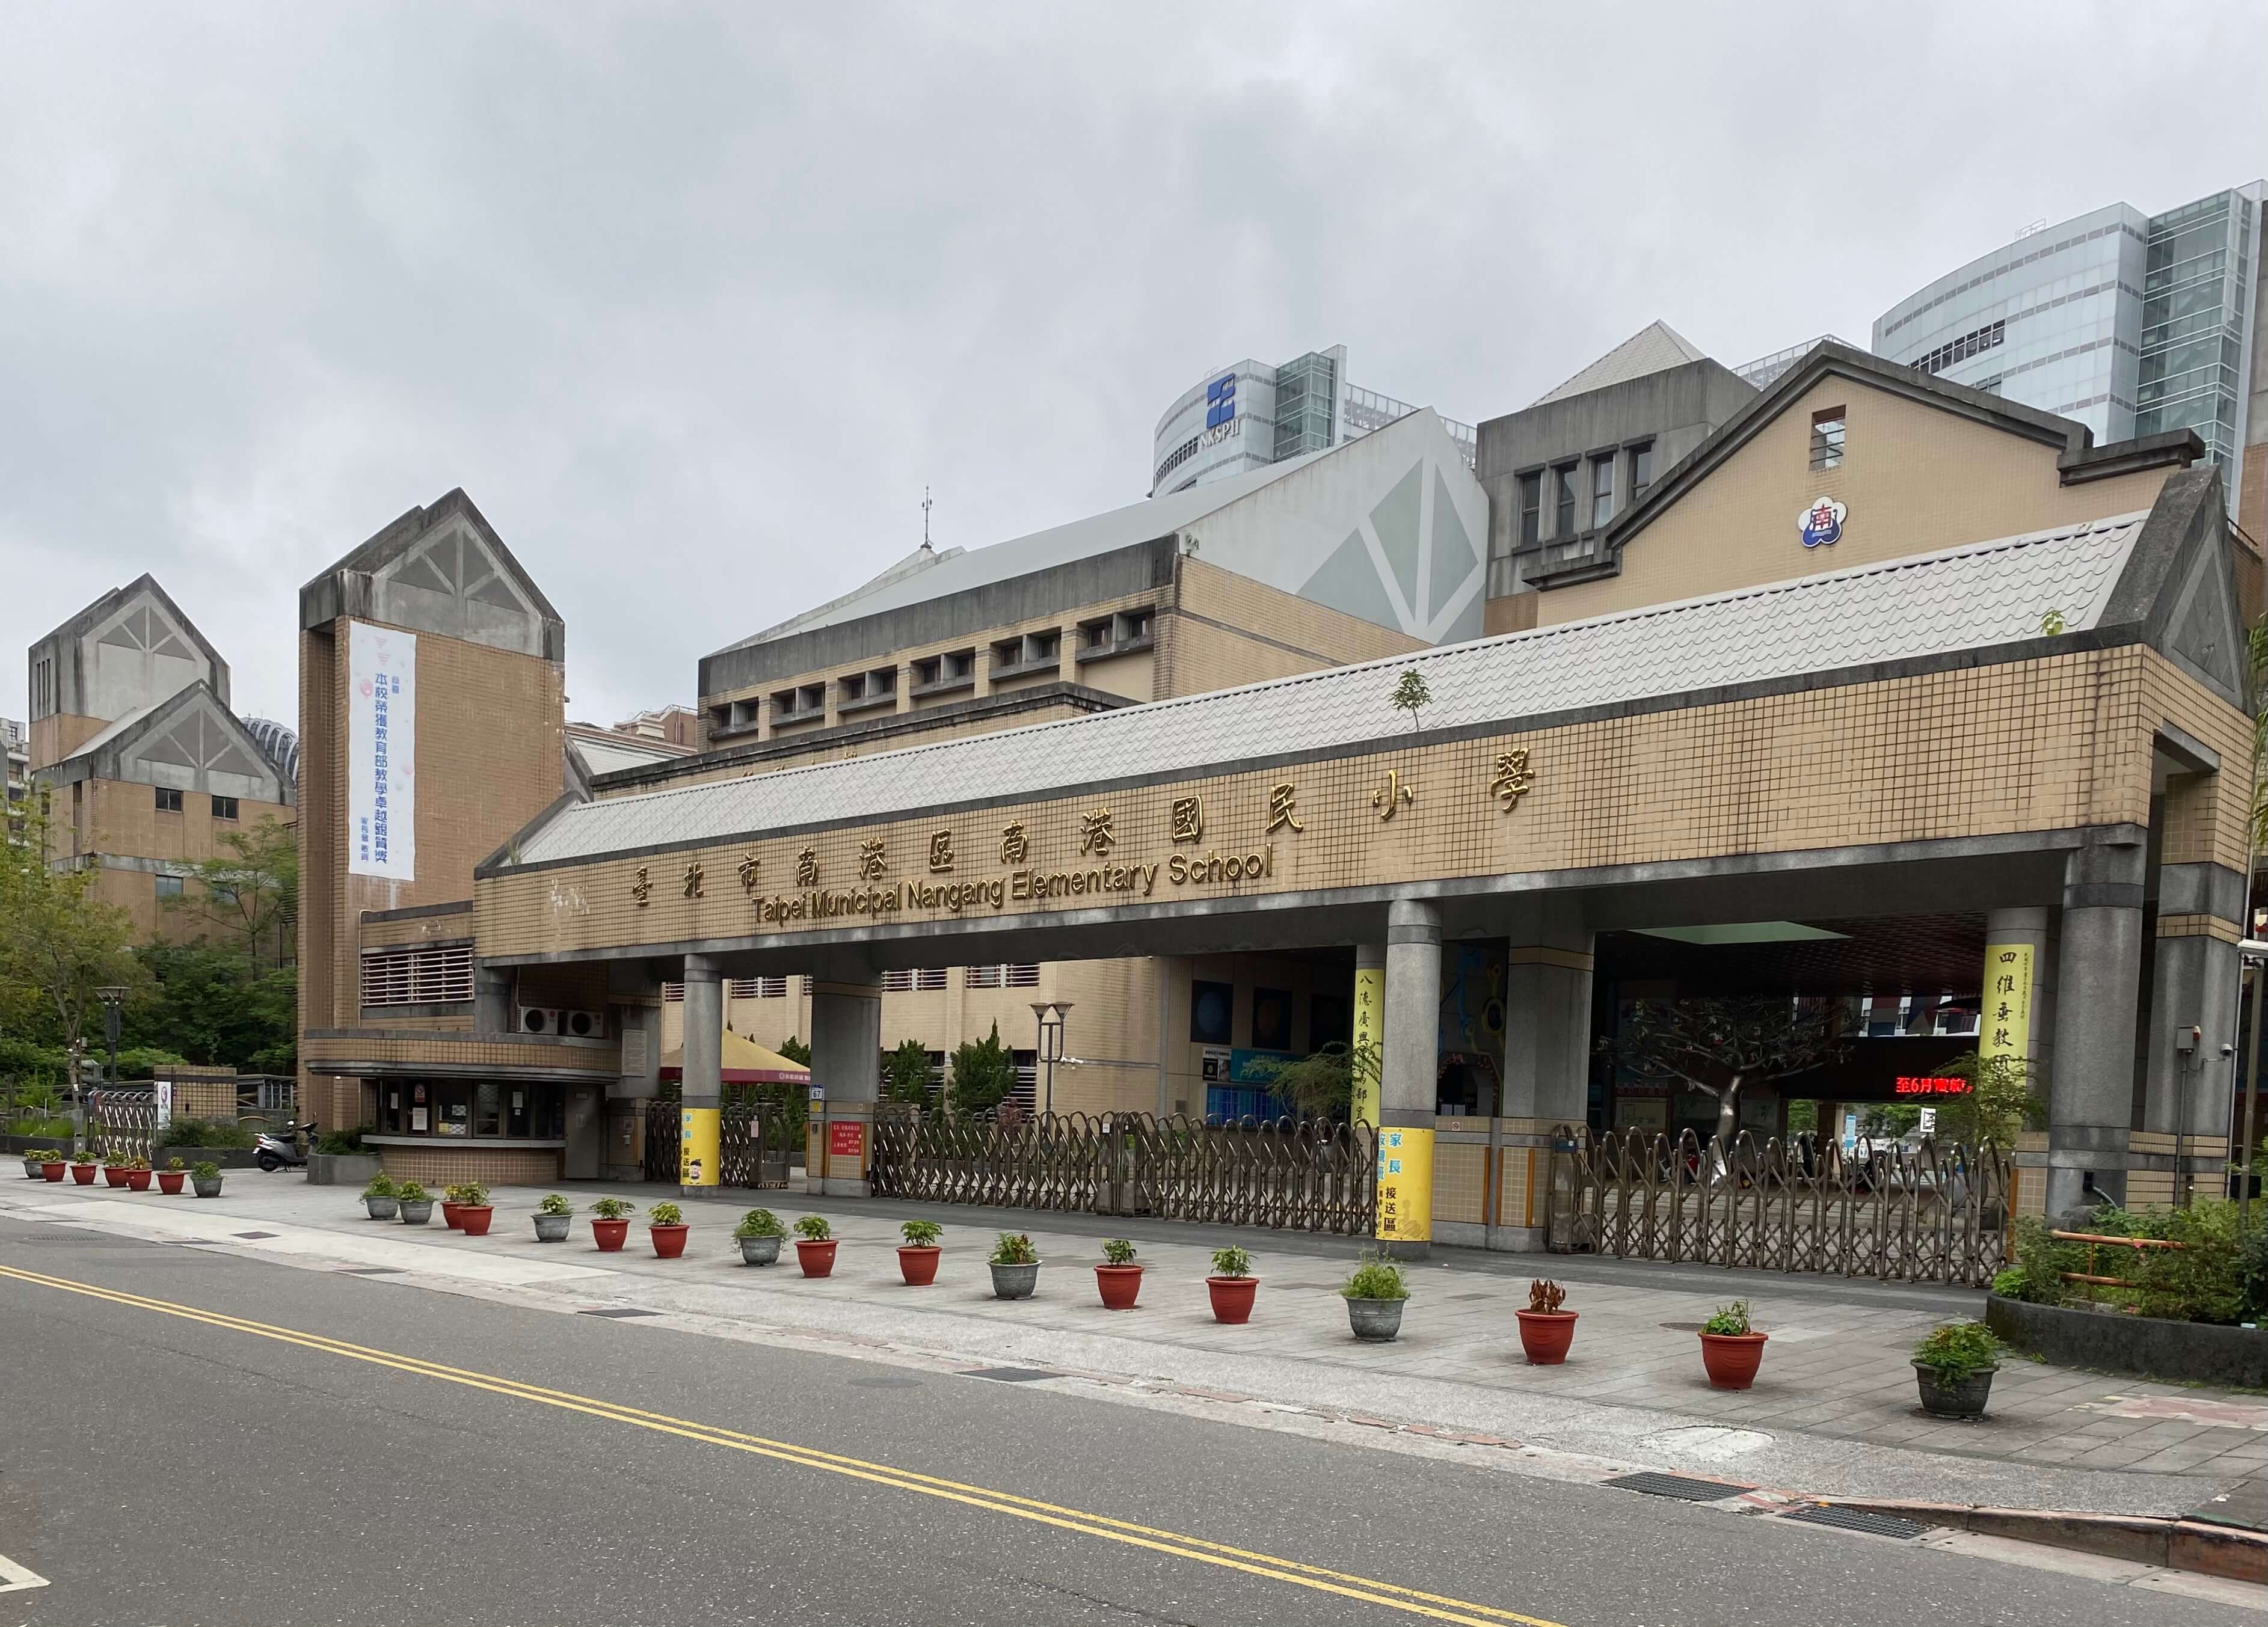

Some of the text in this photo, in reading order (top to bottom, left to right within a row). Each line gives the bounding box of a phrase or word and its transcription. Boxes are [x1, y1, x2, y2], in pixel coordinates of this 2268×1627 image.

[753, 843, 1273, 927] Taipei Municipal Nangang Elementary School
[813, 1089, 822, 1098] 67
